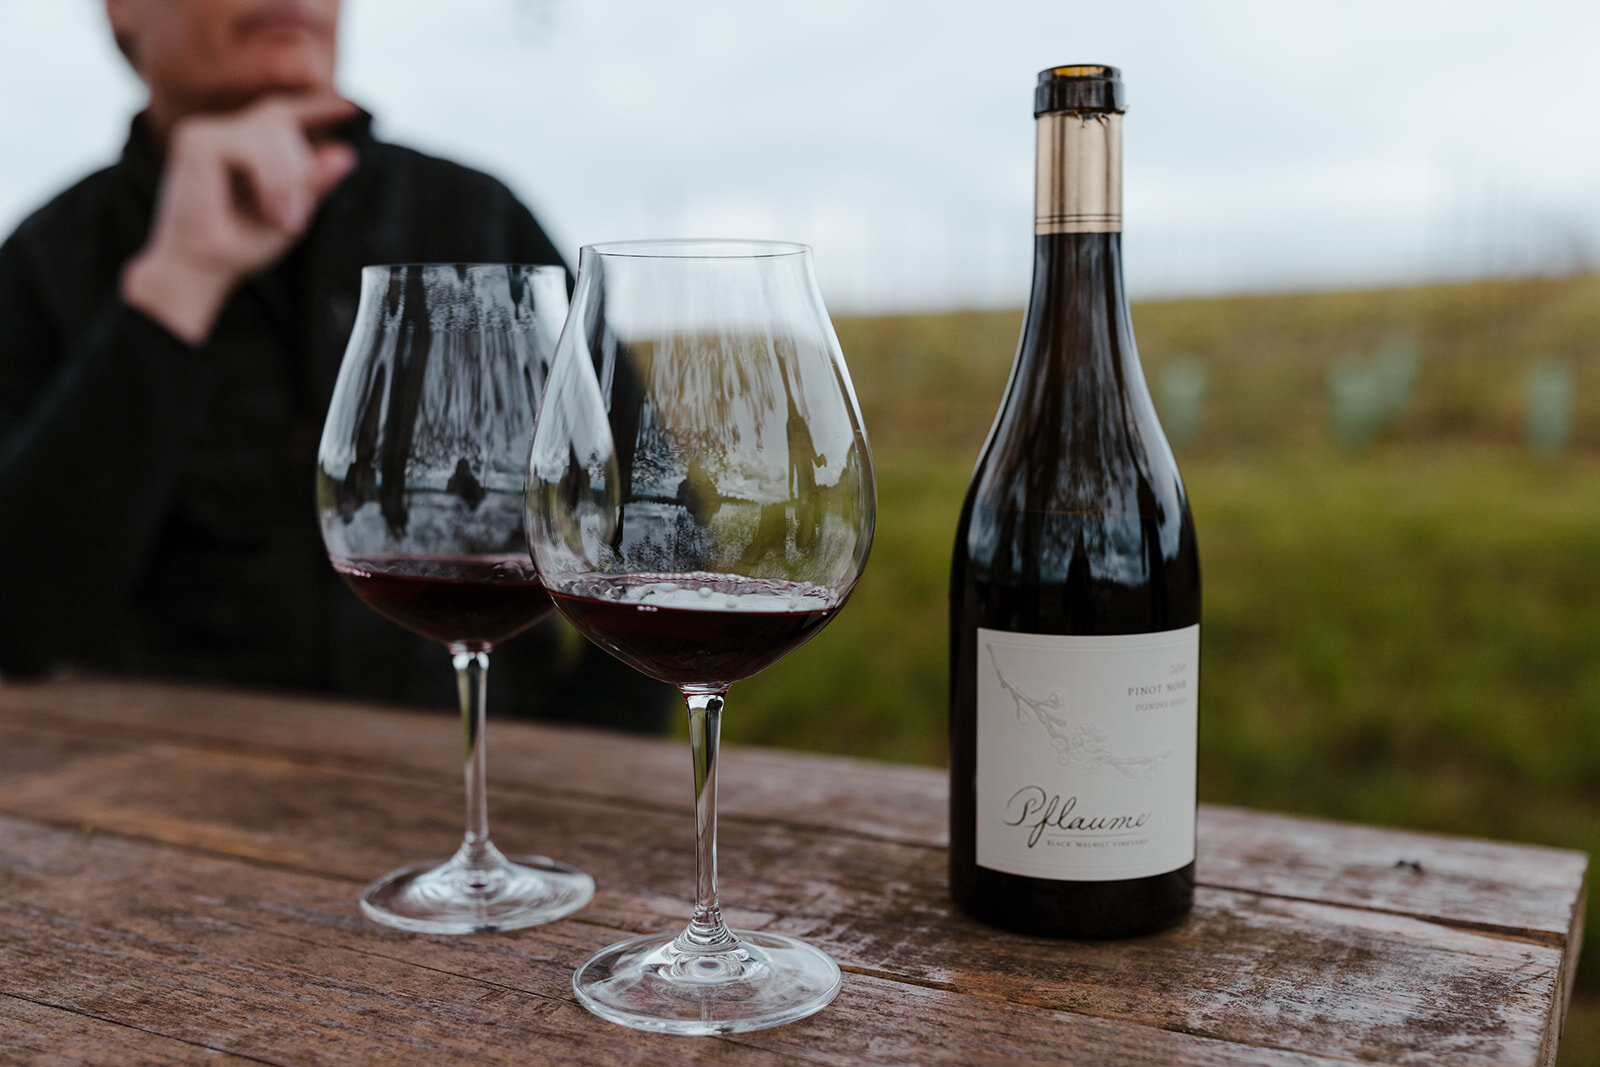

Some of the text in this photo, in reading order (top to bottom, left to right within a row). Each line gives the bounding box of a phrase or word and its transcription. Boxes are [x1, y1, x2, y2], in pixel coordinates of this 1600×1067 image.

[1127, 683, 1162, 697] PINOT
[1001, 785, 1152, 849] Pflaume
[1047, 839, 1071, 847] BLACK
